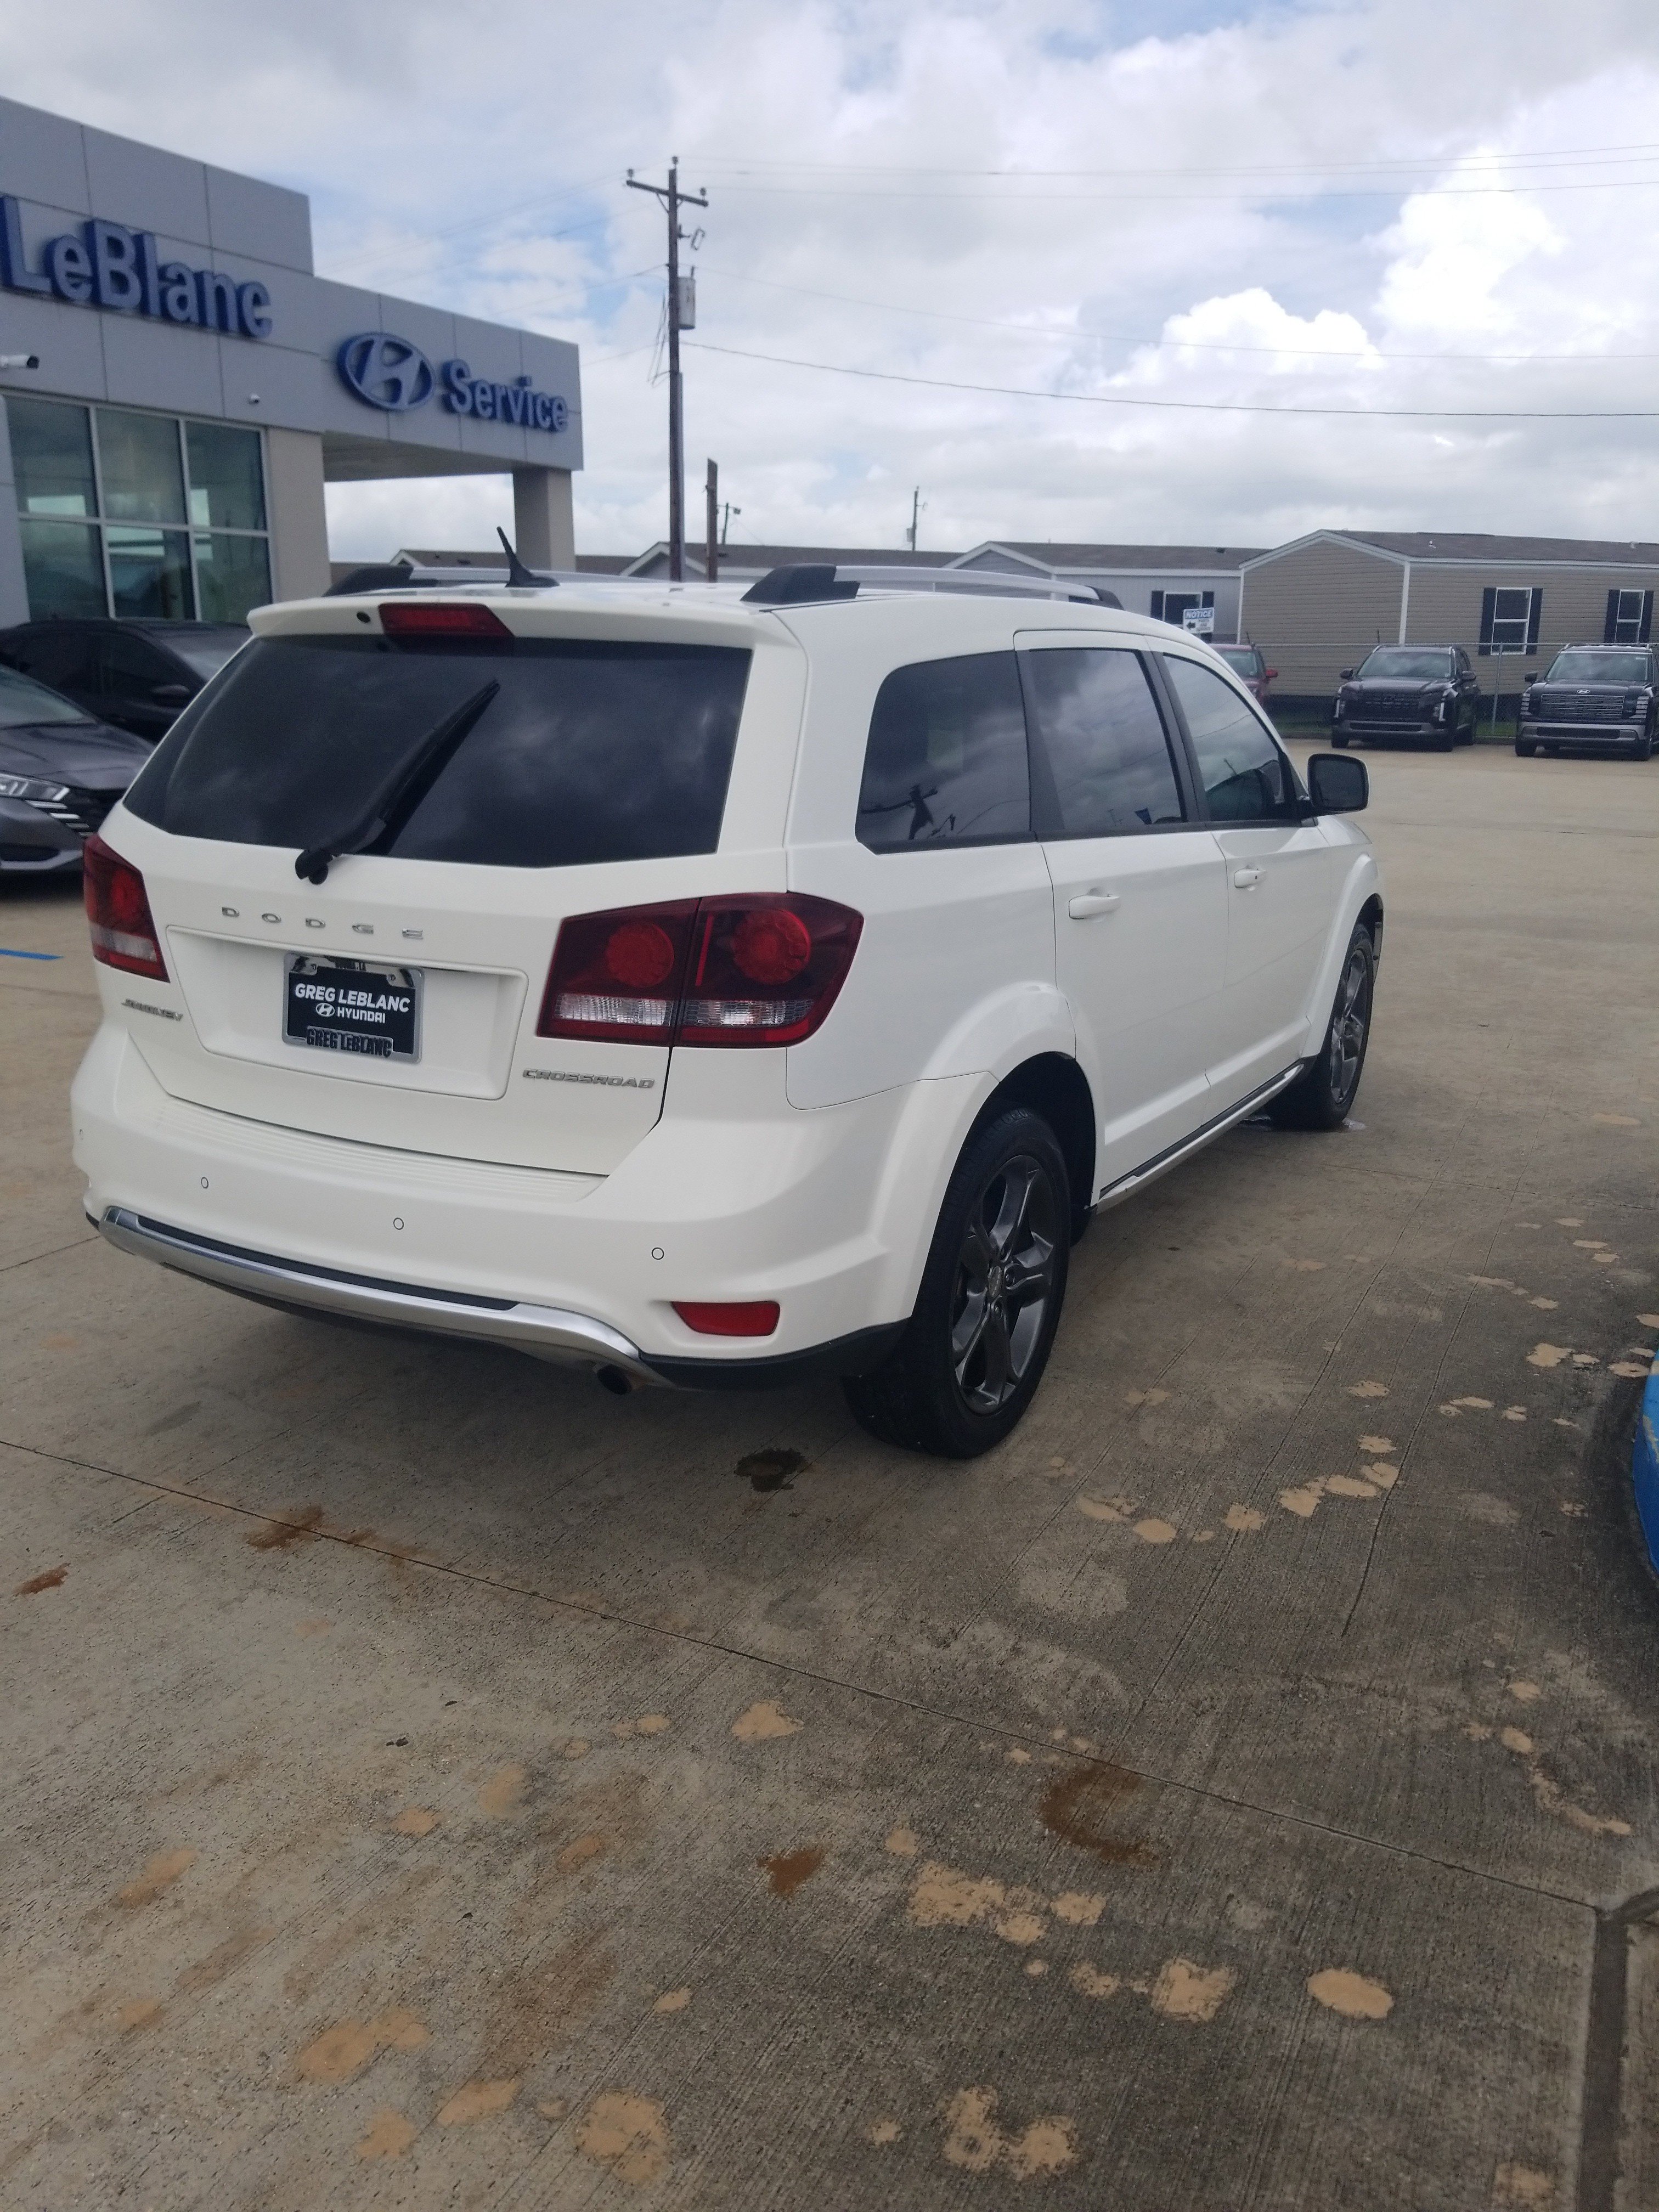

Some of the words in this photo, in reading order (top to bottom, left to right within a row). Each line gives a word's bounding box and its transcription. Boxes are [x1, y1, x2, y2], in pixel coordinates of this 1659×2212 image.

[0, 195, 273, 337] LeBlanc
[441, 358, 568, 432] Service
[222, 906, 424, 940] DODGE
[295, 983, 336, 1002] GREG
[338, 989, 410, 1013] LEBLANC
[337, 1006, 386, 1024] HYUNDAI
[306, 1027, 338, 1049] GREG
[339, 1032, 393, 1058] LEBLANC
[522, 1069, 655, 1088] CROSSROAD
